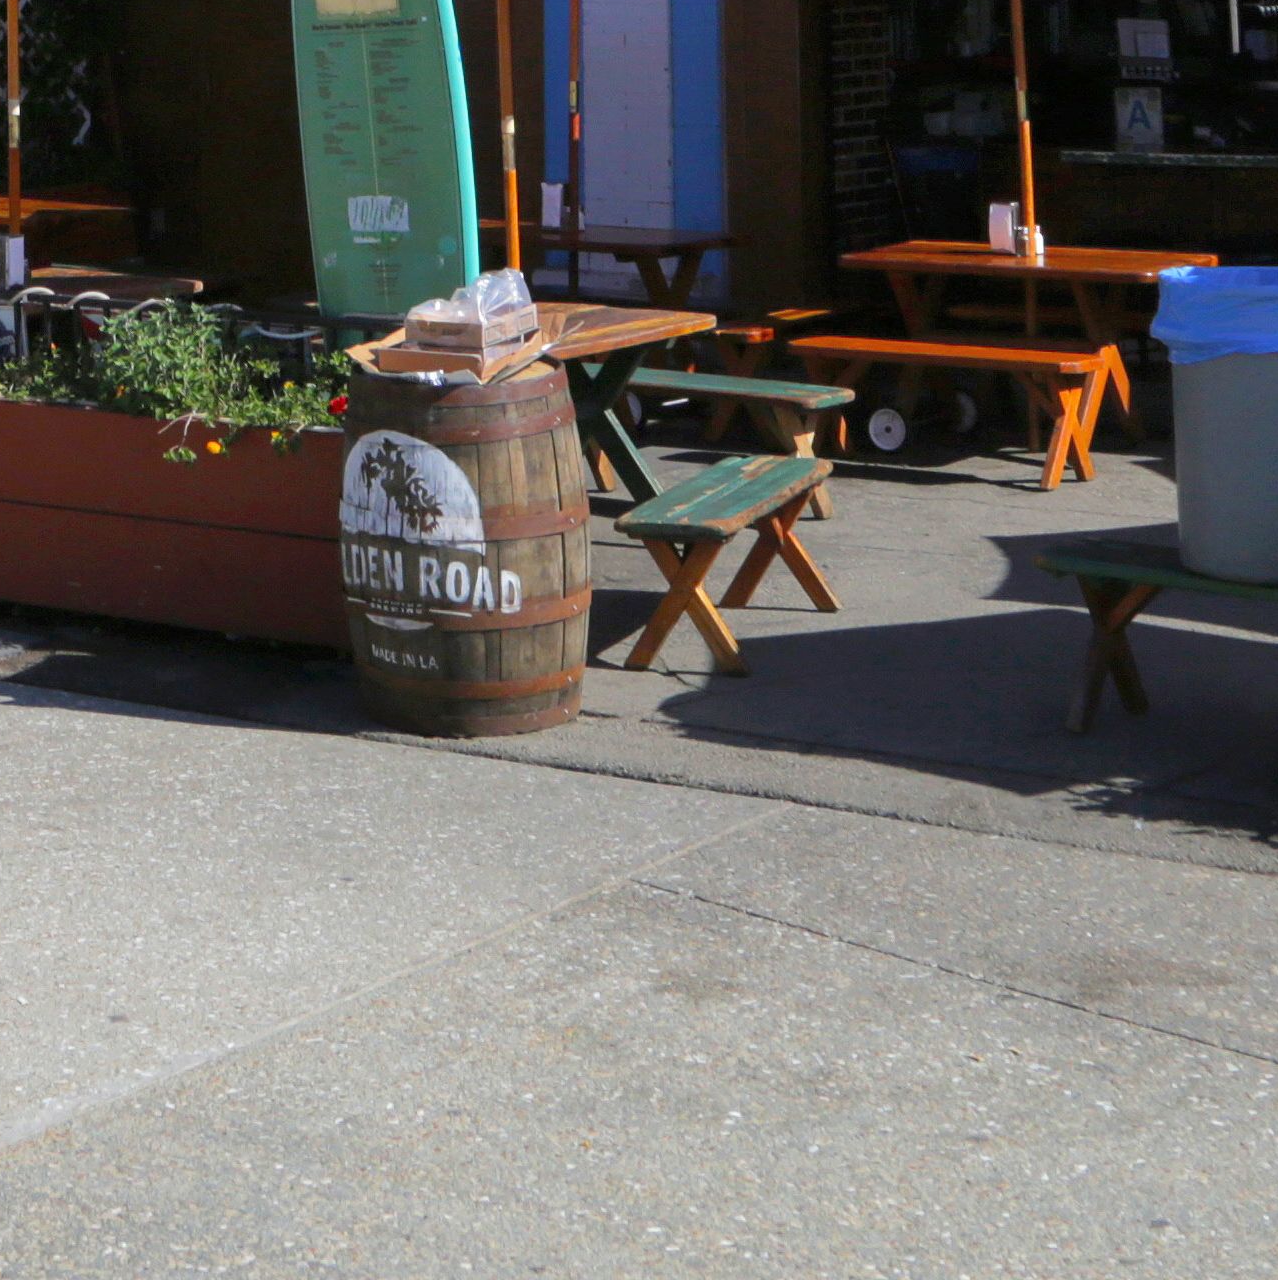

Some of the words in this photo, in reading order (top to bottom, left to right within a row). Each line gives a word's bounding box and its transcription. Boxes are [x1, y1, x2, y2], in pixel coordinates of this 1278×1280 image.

[418, 556, 521, 614] ROAD
[371, 643, 398, 665] MADE
[403, 652, 416, 667] IN
[419, 657, 439, 671] LA
